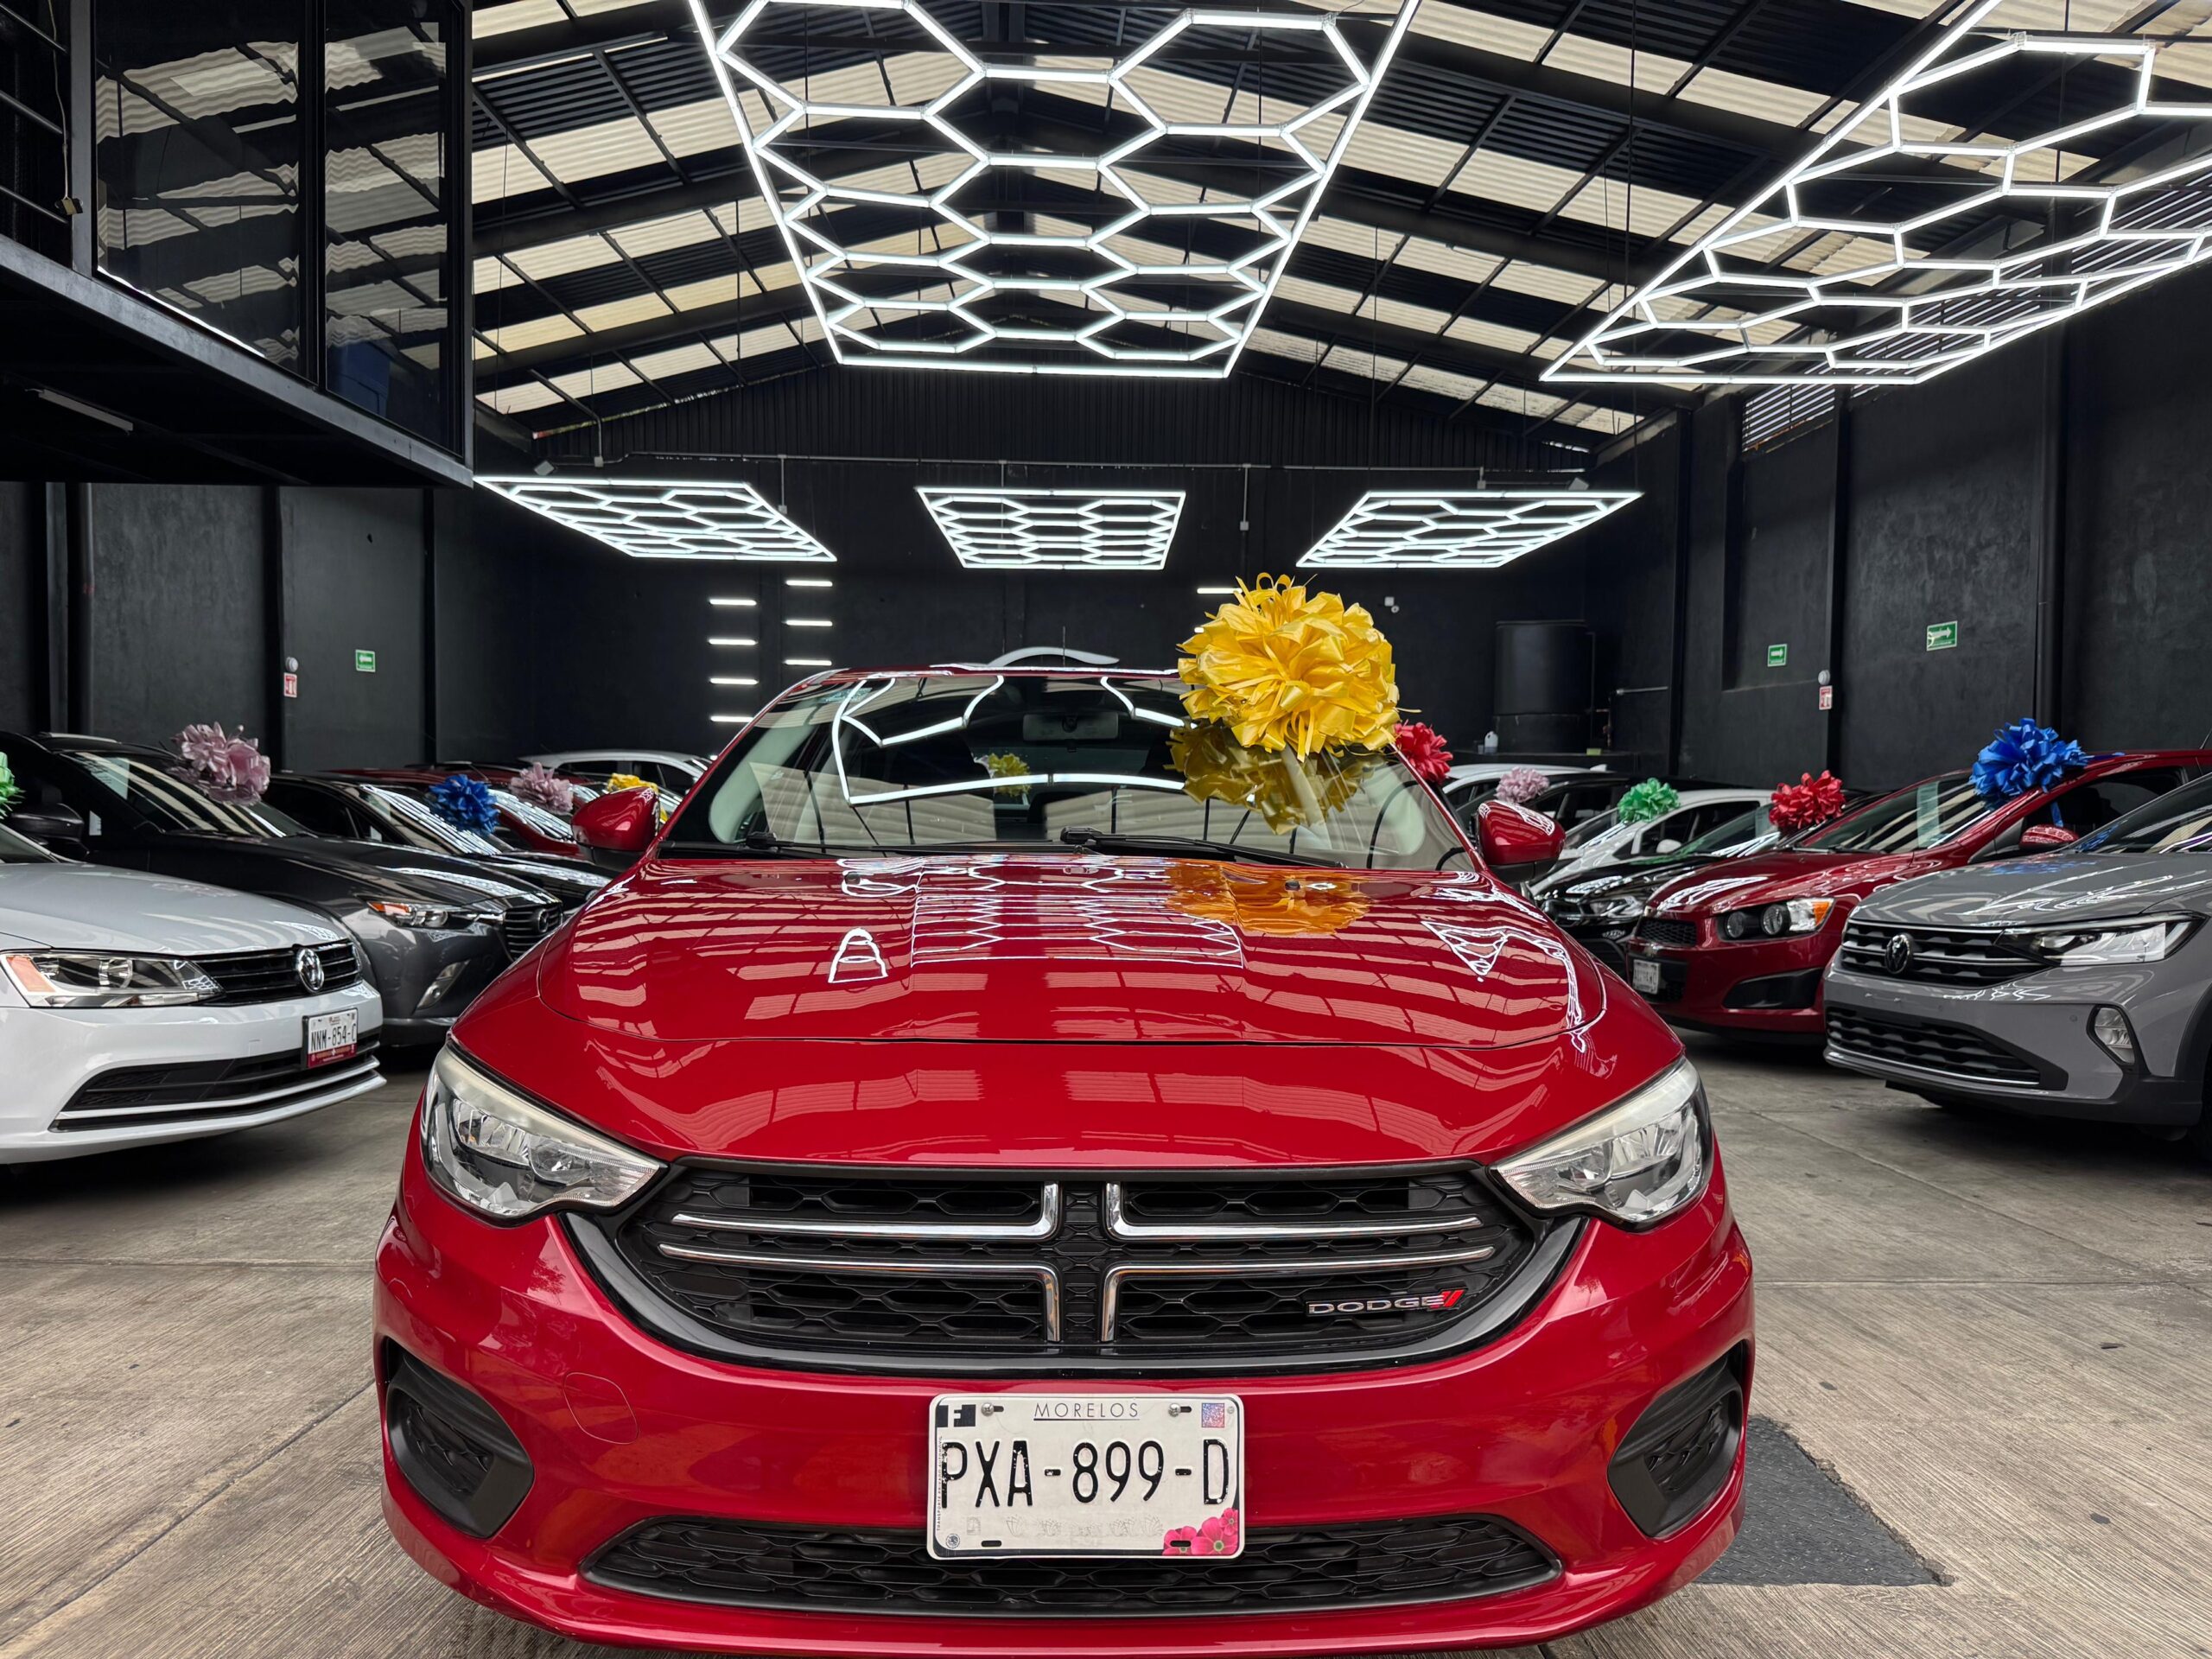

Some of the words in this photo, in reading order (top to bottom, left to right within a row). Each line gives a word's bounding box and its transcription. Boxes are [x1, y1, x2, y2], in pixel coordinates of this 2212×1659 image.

[1308, 1294, 1445, 1314] DODGE
[1034, 1402, 1138, 1418] MORELOS
[941, 1439, 1230, 1509] PXA-899-D
